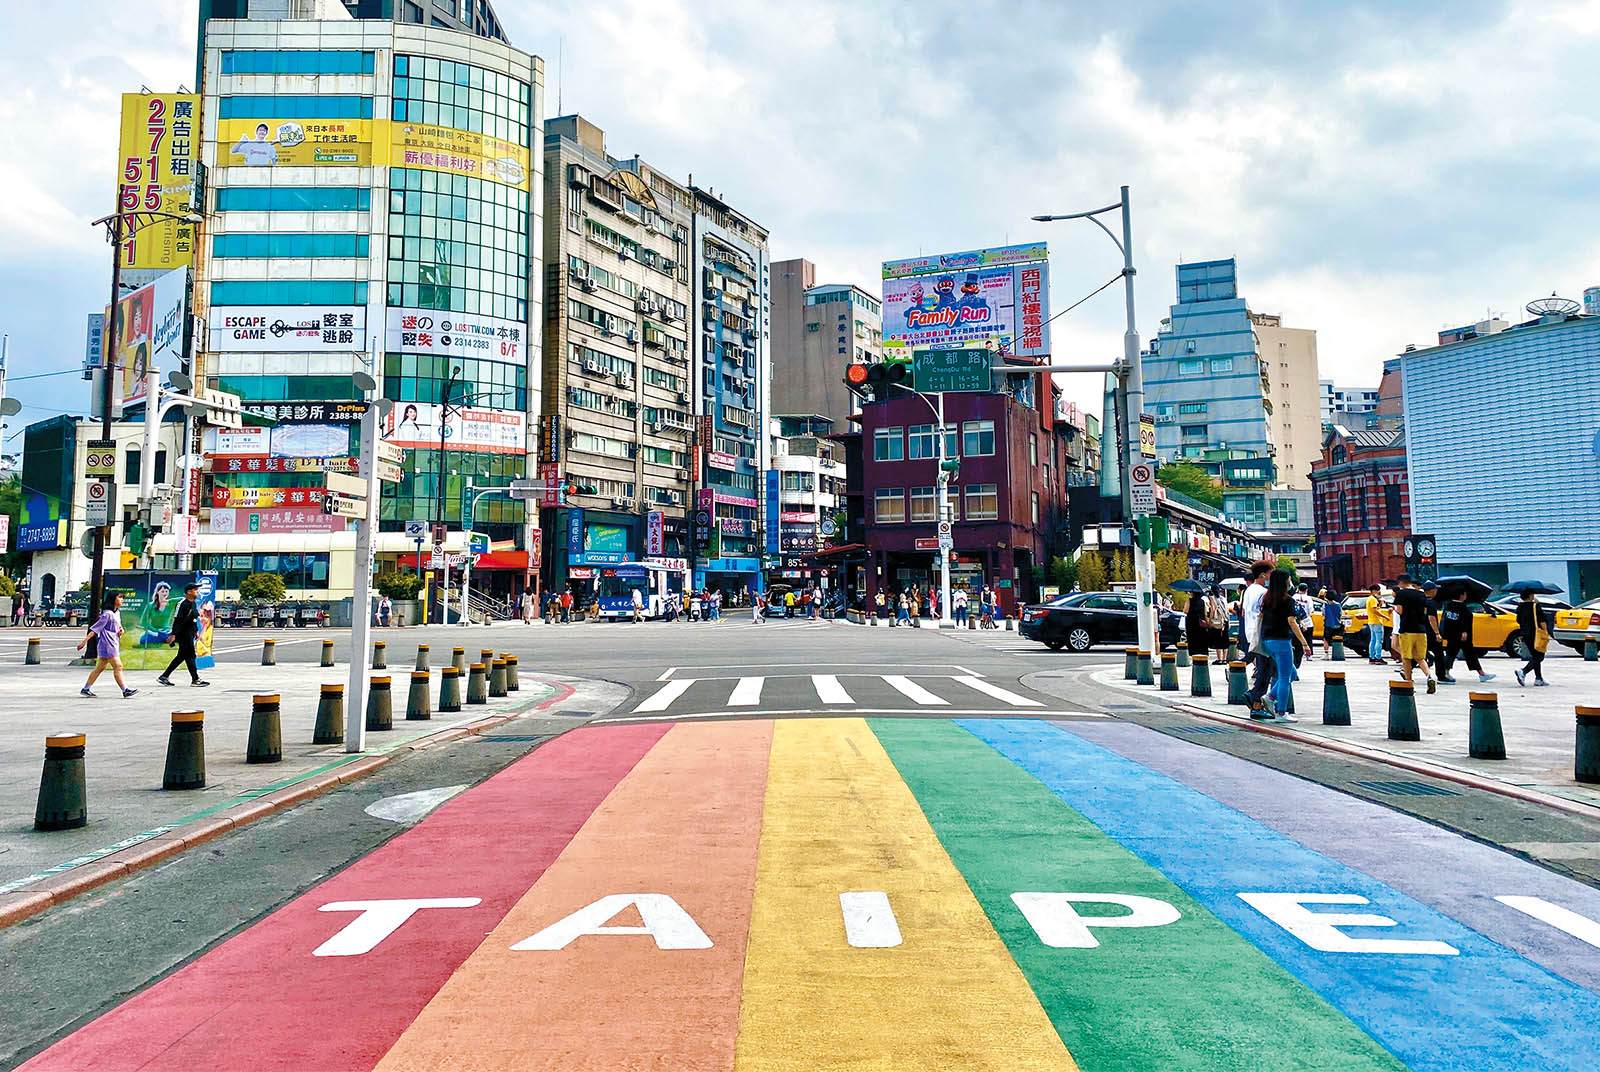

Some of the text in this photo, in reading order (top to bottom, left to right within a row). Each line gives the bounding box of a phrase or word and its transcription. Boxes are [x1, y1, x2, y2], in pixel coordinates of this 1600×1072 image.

[170, 101, 193, 176] 廣告出租
[313, 134, 358, 143] 工作生活吧
[161, 197, 175, 264] Adertising
[177, 202, 191, 252] 奇廣告
[1021, 268, 1042, 349] 西門紅樓電視牆
[225, 316, 266, 327] ESCAPE
[323, 313, 353, 327] 密室
[908, 306, 988, 327] Family Run
[233, 329, 266, 340] GAME
[323, 329, 353, 343] 逃脫
[454, 322, 495, 336] LOSTTW.COM
[497, 325, 520, 342] 本棟
[454, 337, 490, 350] 2314 2383
[500, 341, 518, 358] 6/F
[922, 351, 981, 365] 成都路
[336, 404, 365, 412] DrPlus
[216, 490, 230, 499] 3F
[27, 526, 56, 543] 2747-8899
[313, 892, 1600, 958] TAIPEI
